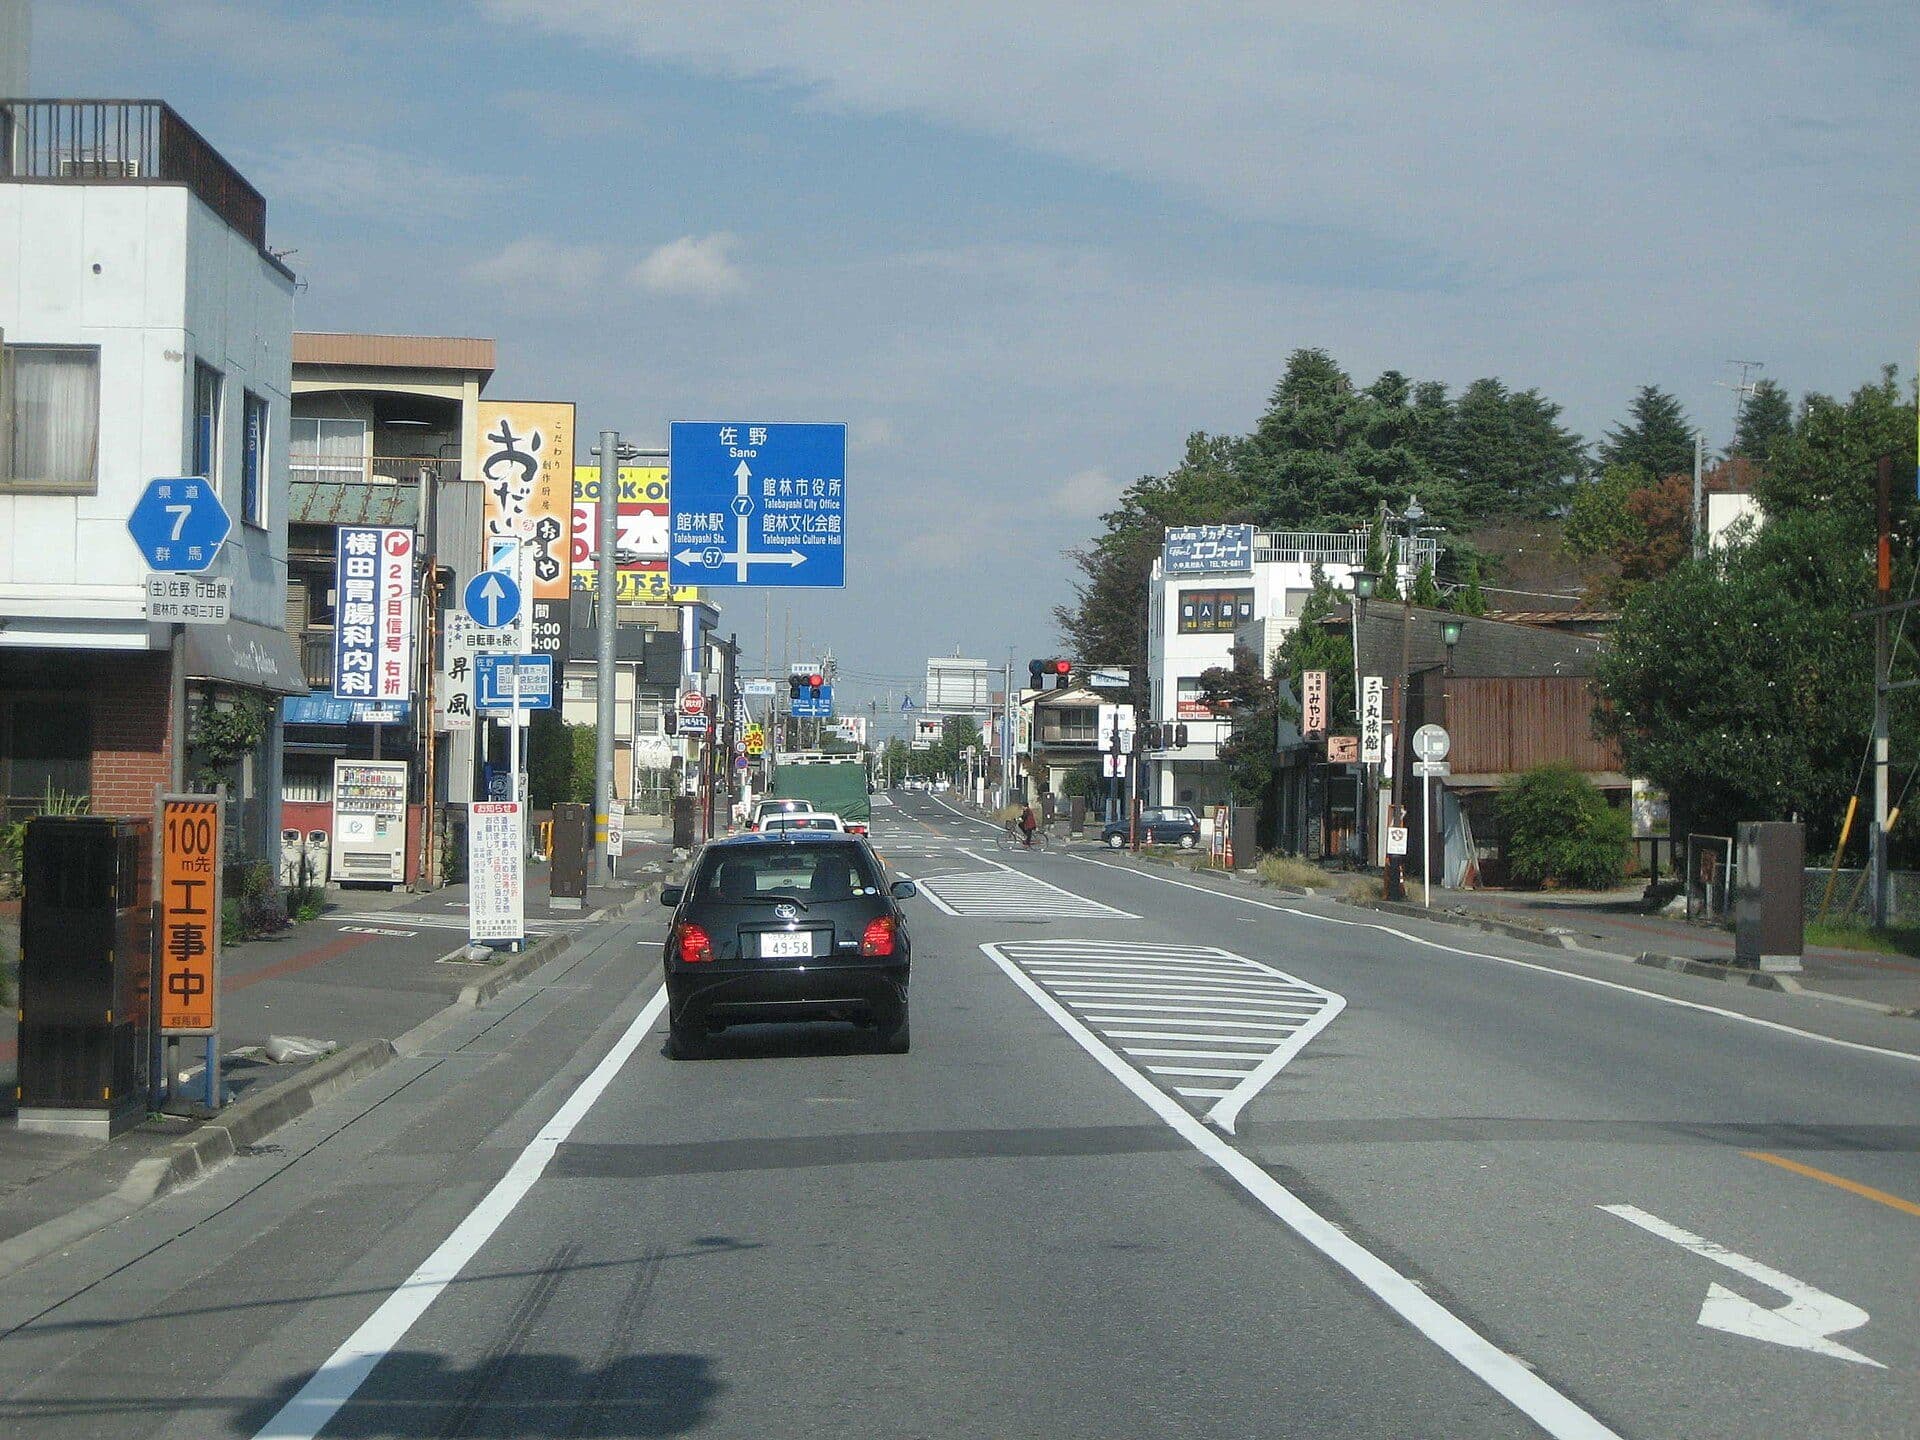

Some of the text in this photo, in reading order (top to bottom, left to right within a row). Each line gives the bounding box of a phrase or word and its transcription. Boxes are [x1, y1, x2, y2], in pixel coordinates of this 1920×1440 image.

[719, 427, 767, 446] 佐野
[553, 421, 562, 470] こだわり
[729, 447, 757, 458] Sano
[158, 485, 199, 499] 県道
[763, 478, 842, 497] 館林市役所
[738, 499, 748, 513] 7
[764, 498, 841, 511] Tatebayashi City Office
[165, 504, 192, 541] 7
[676, 512, 724, 532] 館林駅
[762, 513, 842, 533] 館林文化会館
[673, 533, 727, 545] Tatebayashi Sta.
[763, 534, 842, 547] Tatebayashi Culture Hall
[155, 547, 203, 561] 群馬
[706, 552, 720, 564] 57
[195, 581, 228, 598] 行田線
[152, 604, 225, 617] 館林市 本町三丁目
[341, 532, 377, 696] 横田胃腸科内科
[383, 563, 403, 695] 2つ目信号 右折
[466, 634, 520, 647] 自転車を除く
[446, 656, 472, 718] 昇風
[1365, 680, 1380, 751] 三の丸旅館
[168, 818, 211, 855] 100
[181, 857, 211, 873] m先
[168, 879, 208, 1007] 工事中
[773, 942, 809, 955] 49-58
